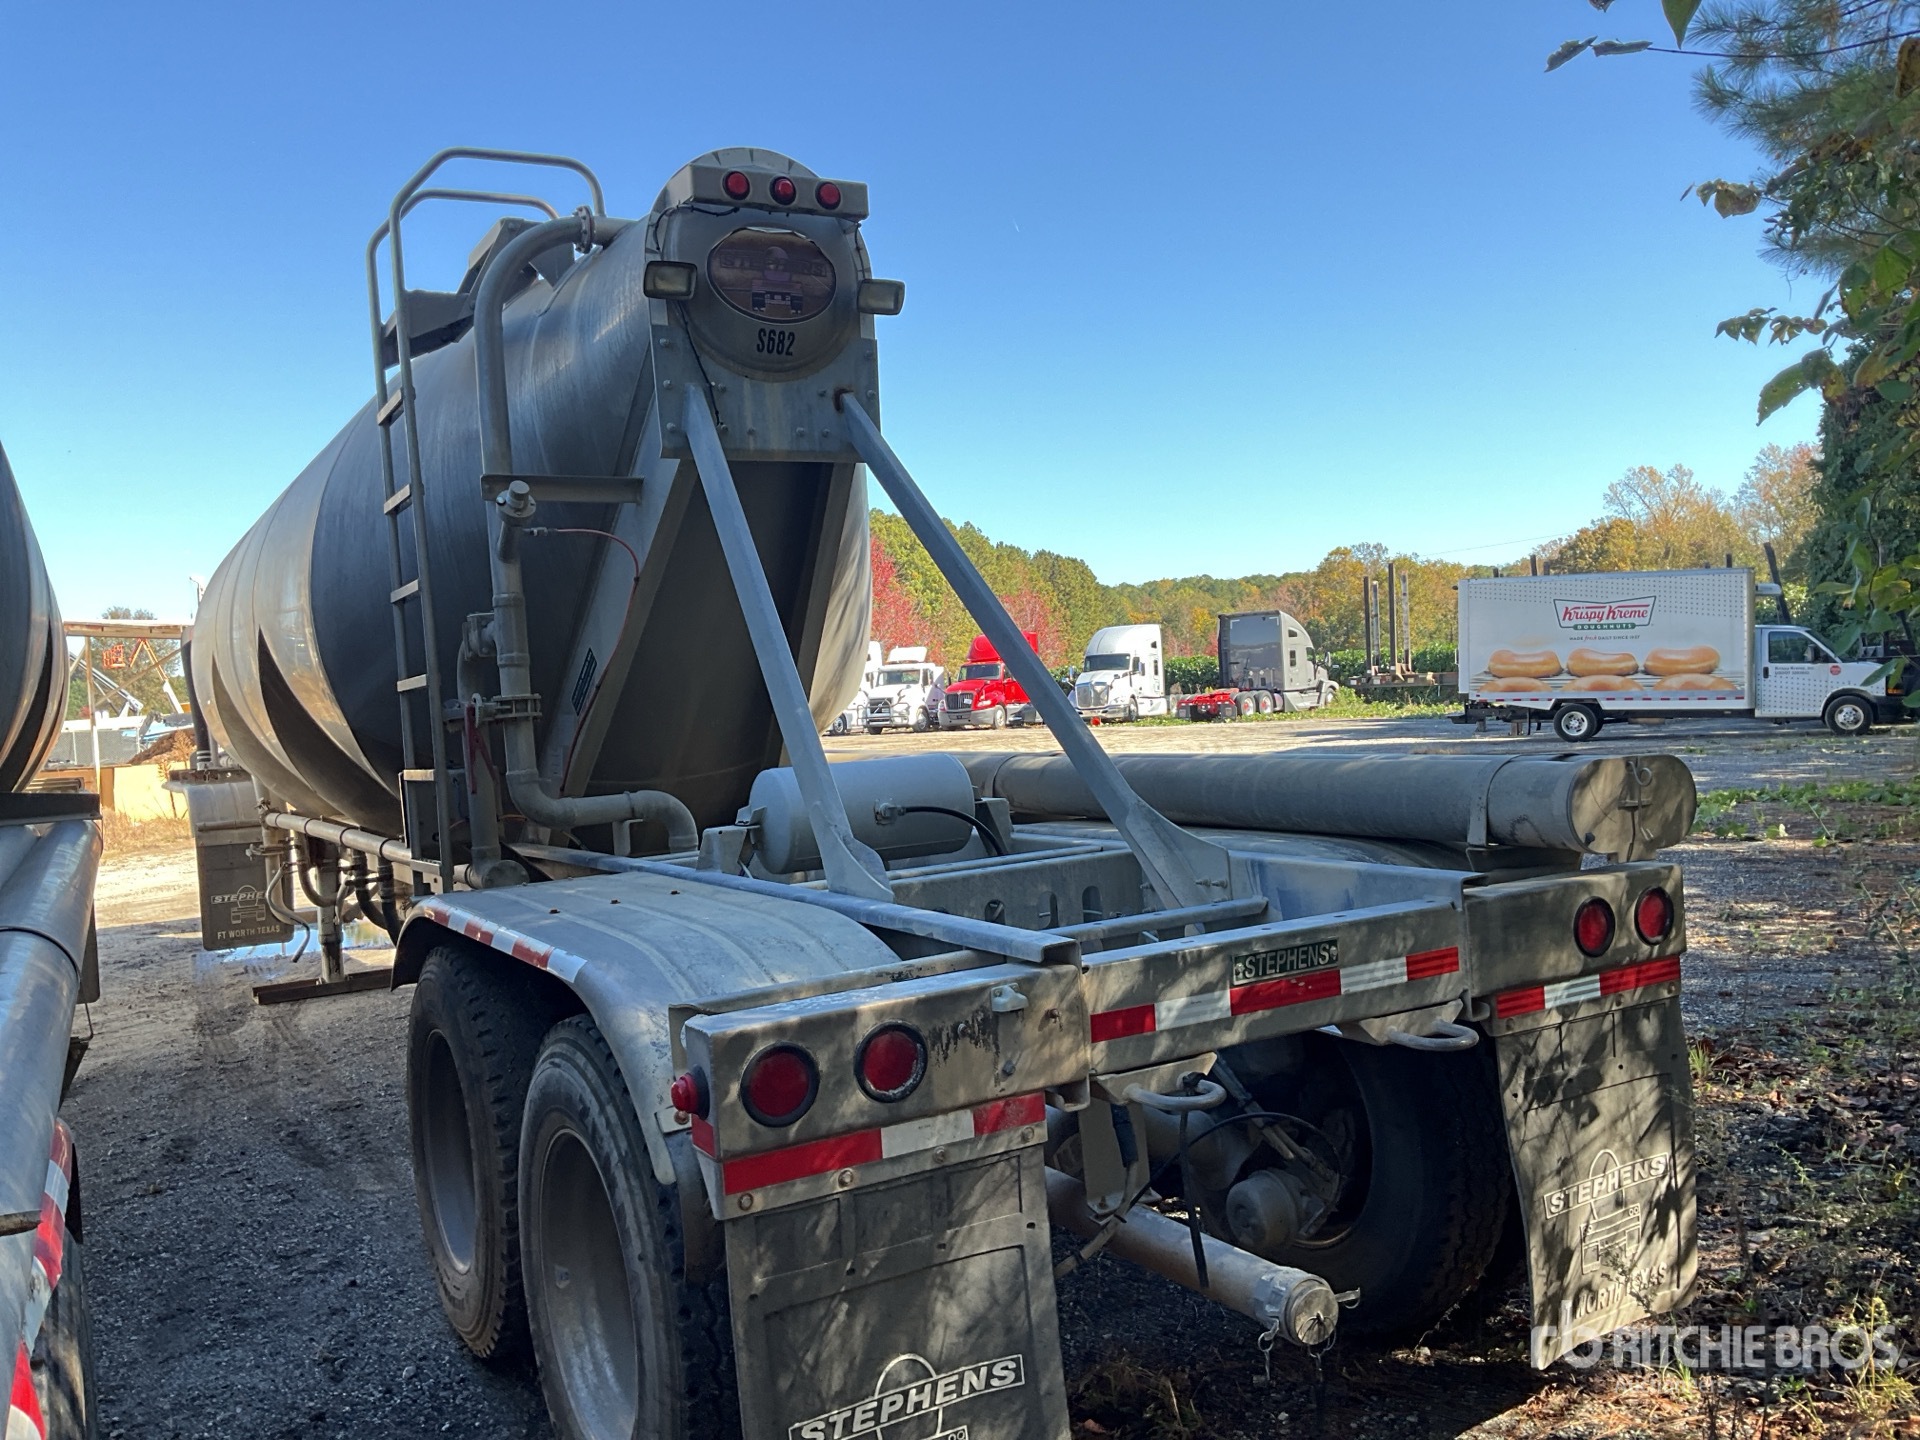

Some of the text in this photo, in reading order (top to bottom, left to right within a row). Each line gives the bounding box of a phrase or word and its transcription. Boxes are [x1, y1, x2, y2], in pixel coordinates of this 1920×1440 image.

[757, 328, 795, 356] S682
[1562, 604, 1650, 622] Krispy Kreme
[214, 892, 266, 903] STEPHE
[217, 924, 281, 940] FT WORTH TEXAS
[1244, 943, 1330, 979] STEPHENS
[1549, 1155, 1666, 1213] STEPHENS
[801, 1360, 1017, 1440] STEPHENS
